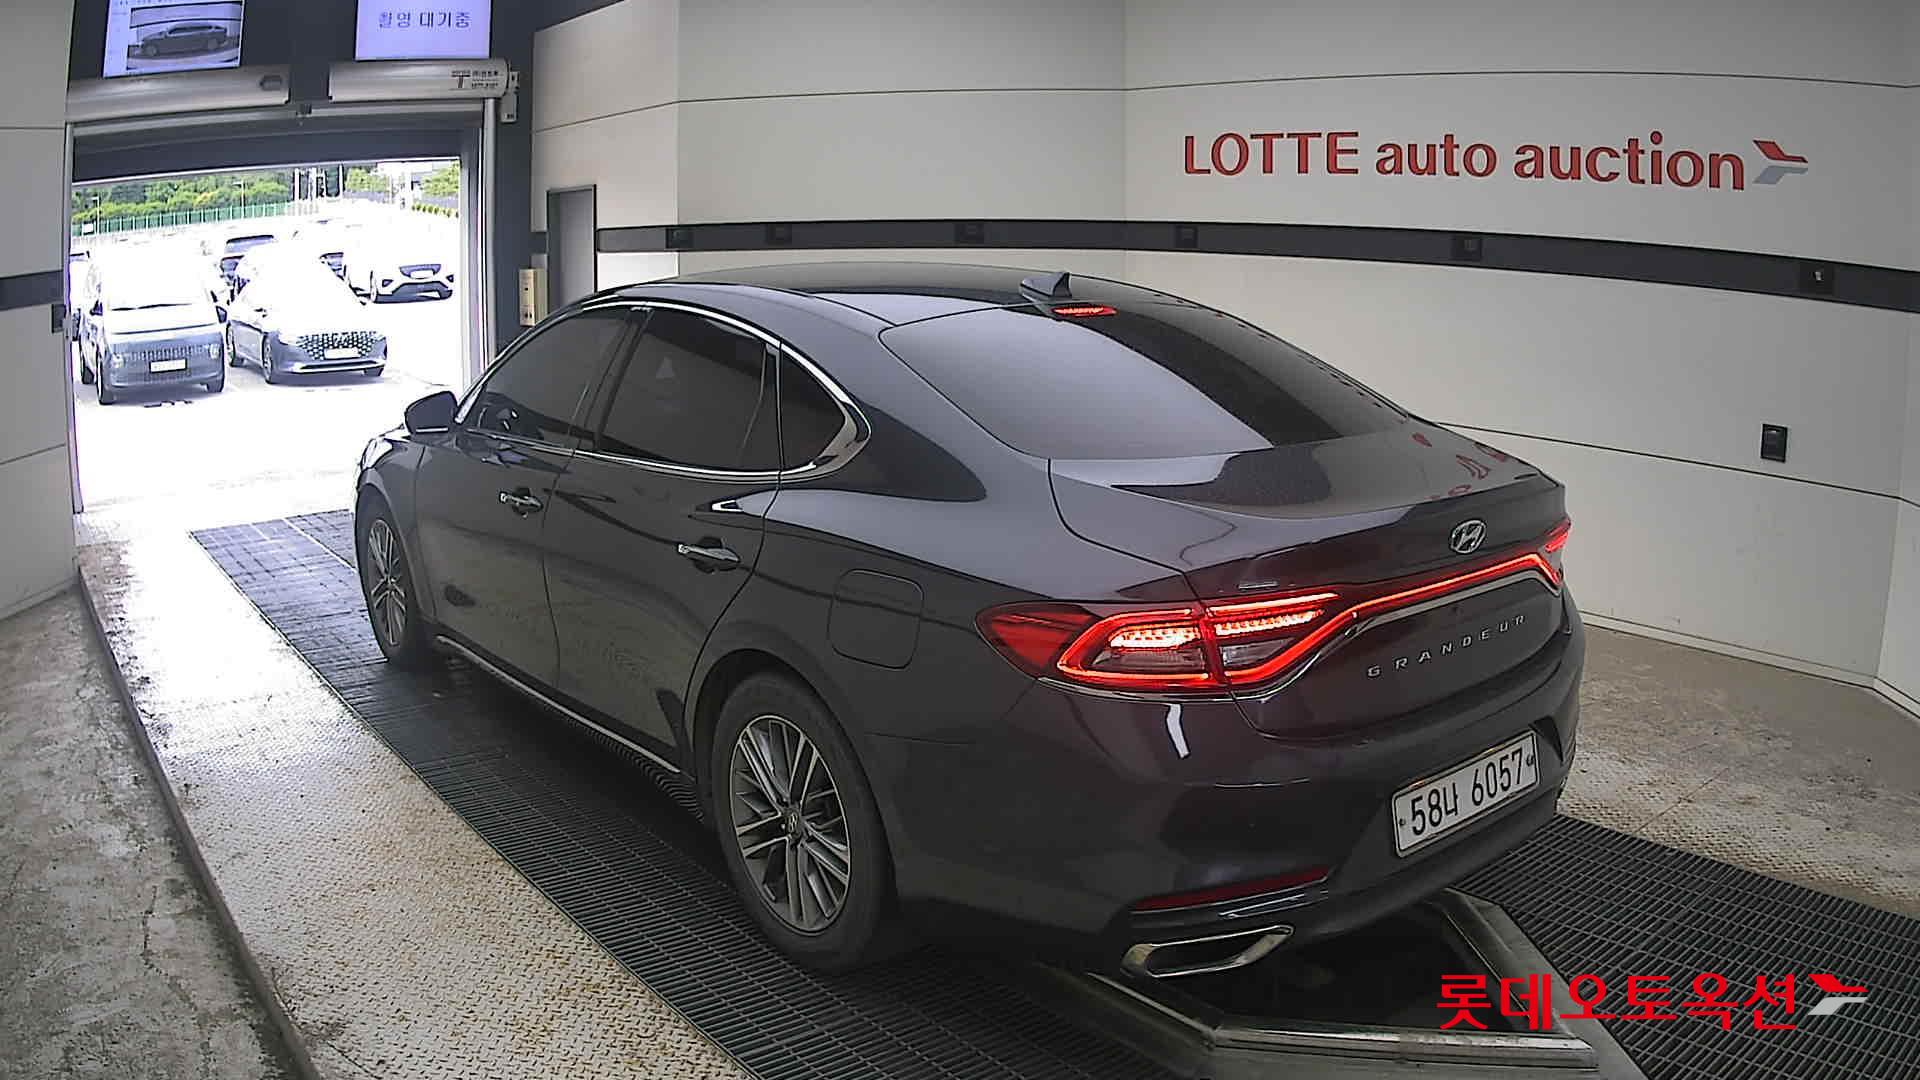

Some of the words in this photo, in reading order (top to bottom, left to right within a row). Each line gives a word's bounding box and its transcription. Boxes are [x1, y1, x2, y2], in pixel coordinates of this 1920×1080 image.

[419, 11, 471, 28] 대기중
[1184, 131, 1359, 176] LOTTE
[1375, 133, 1497, 178] auto
[1513, 131, 1745, 191] auction
[1367, 615, 1526, 678] GRANDEUR
[1410, 782, 1459, 836] 58나
[1471, 747, 1523, 806] 6057
